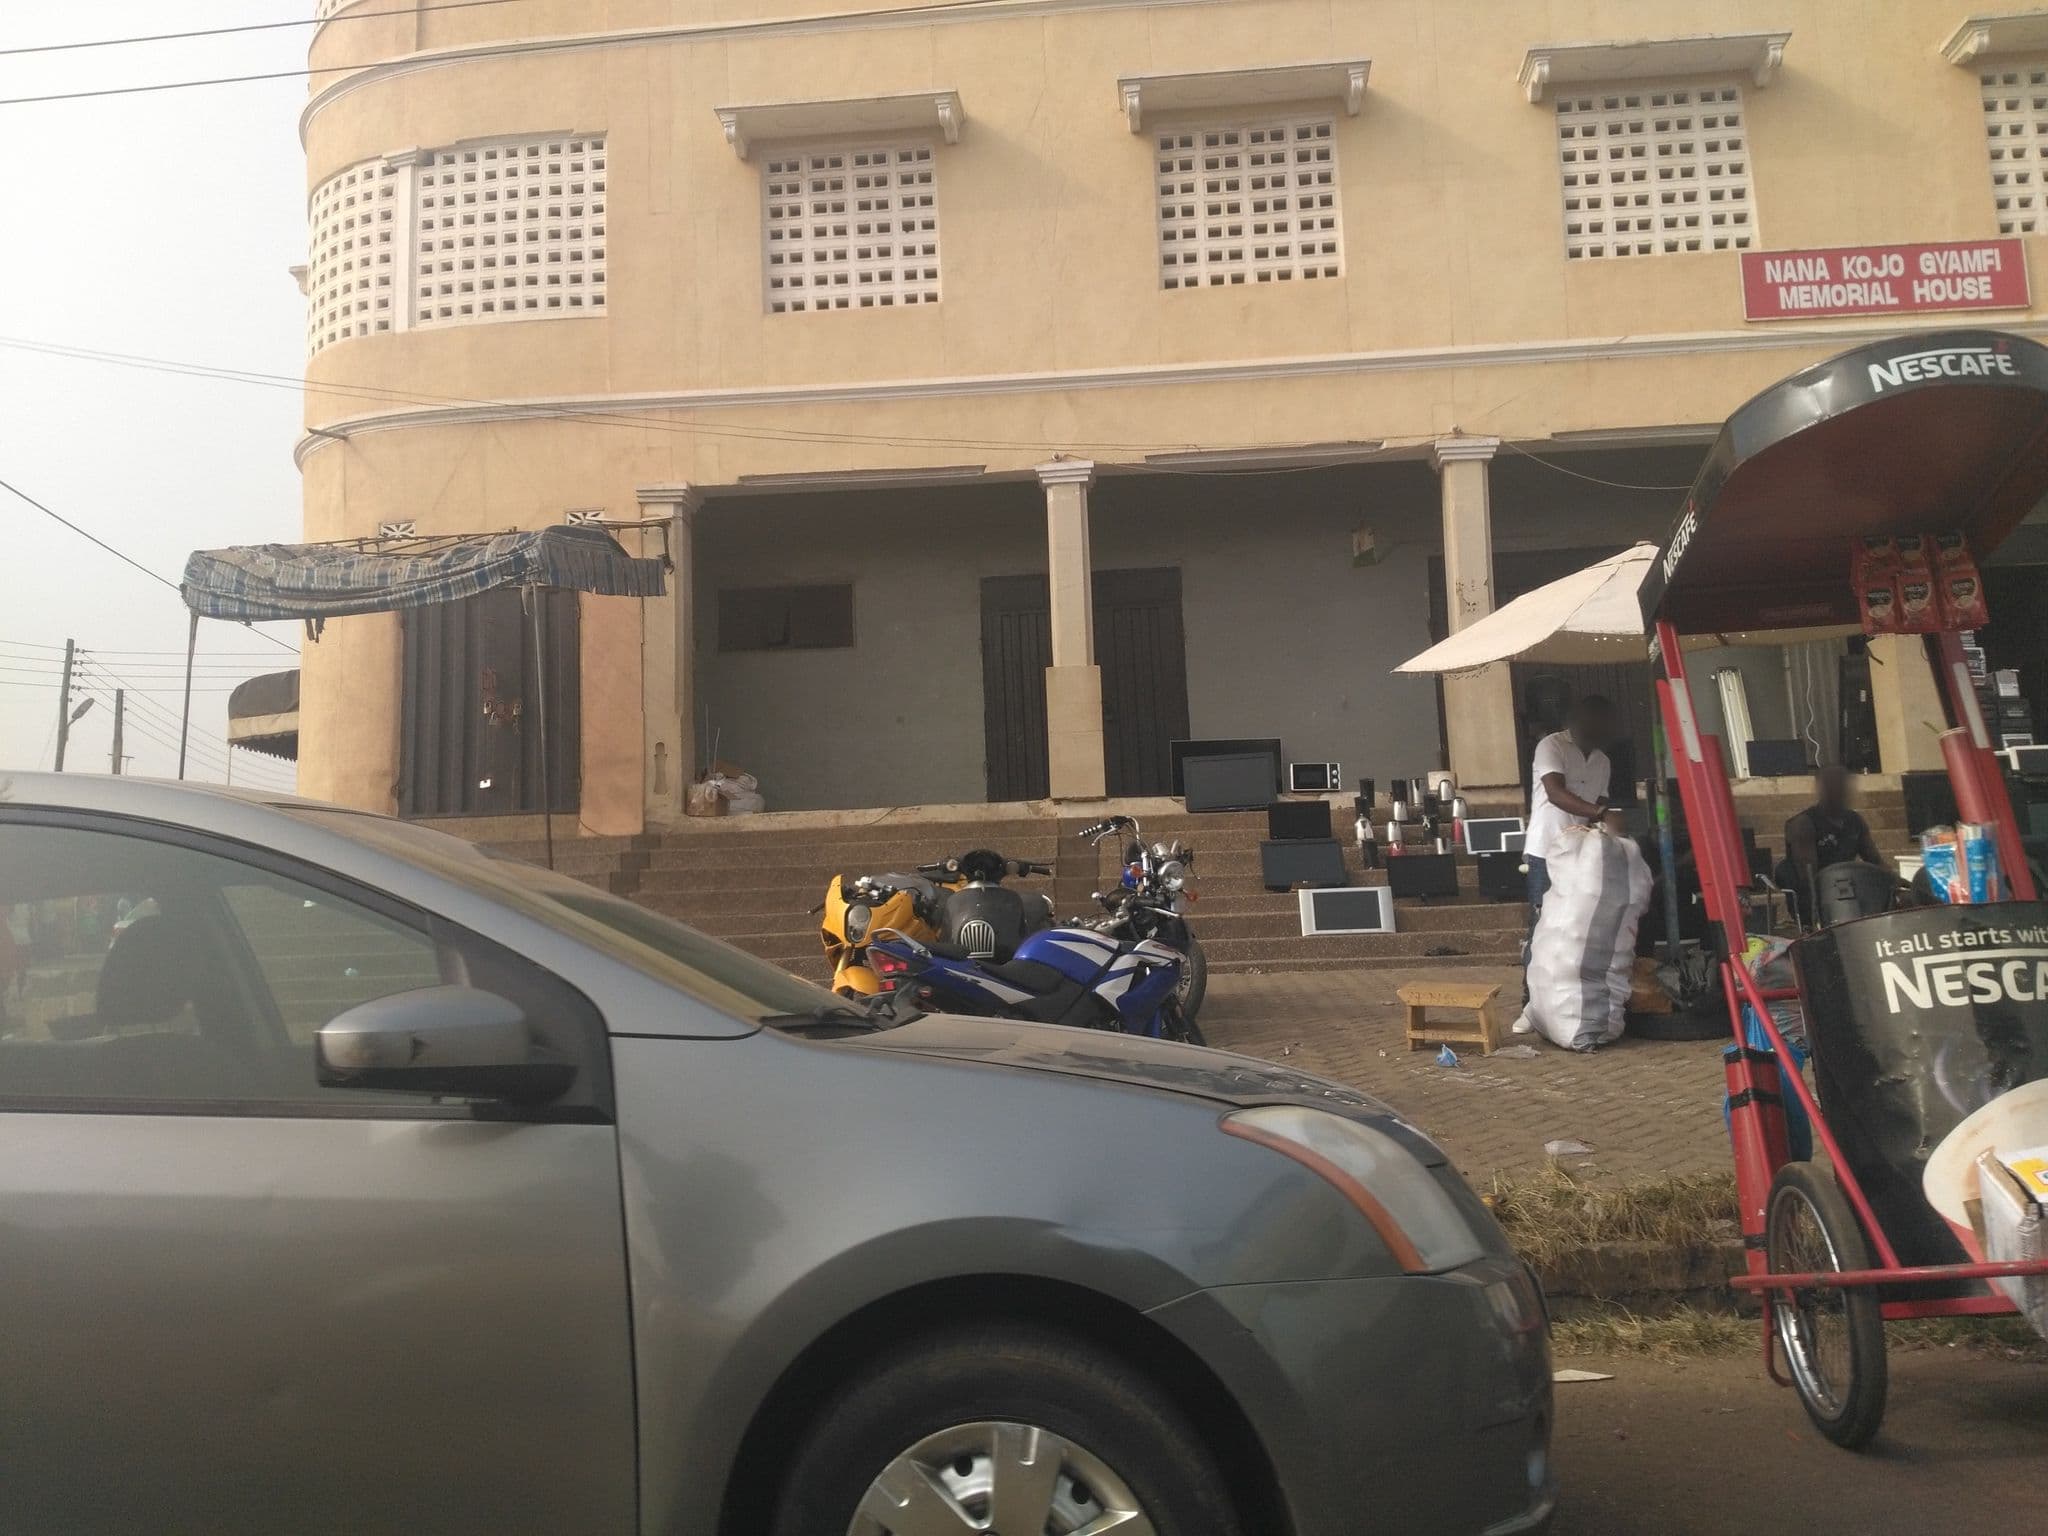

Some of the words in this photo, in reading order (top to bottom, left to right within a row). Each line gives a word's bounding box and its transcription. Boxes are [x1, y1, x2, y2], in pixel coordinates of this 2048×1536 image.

[1764, 257, 1830, 283] NANA
[1842, 253, 1905, 279] KOJO
[1919, 248, 2002, 275] GYAMFI
[1779, 281, 1899, 310] MEMORIAL
[1912, 276, 1993, 303] HOUSE
[1875, 940, 1894, 957] It
[1900, 932, 1933, 953] all
[1939, 927, 2011, 949] starts
[2015, 925, 2048, 944] wit
